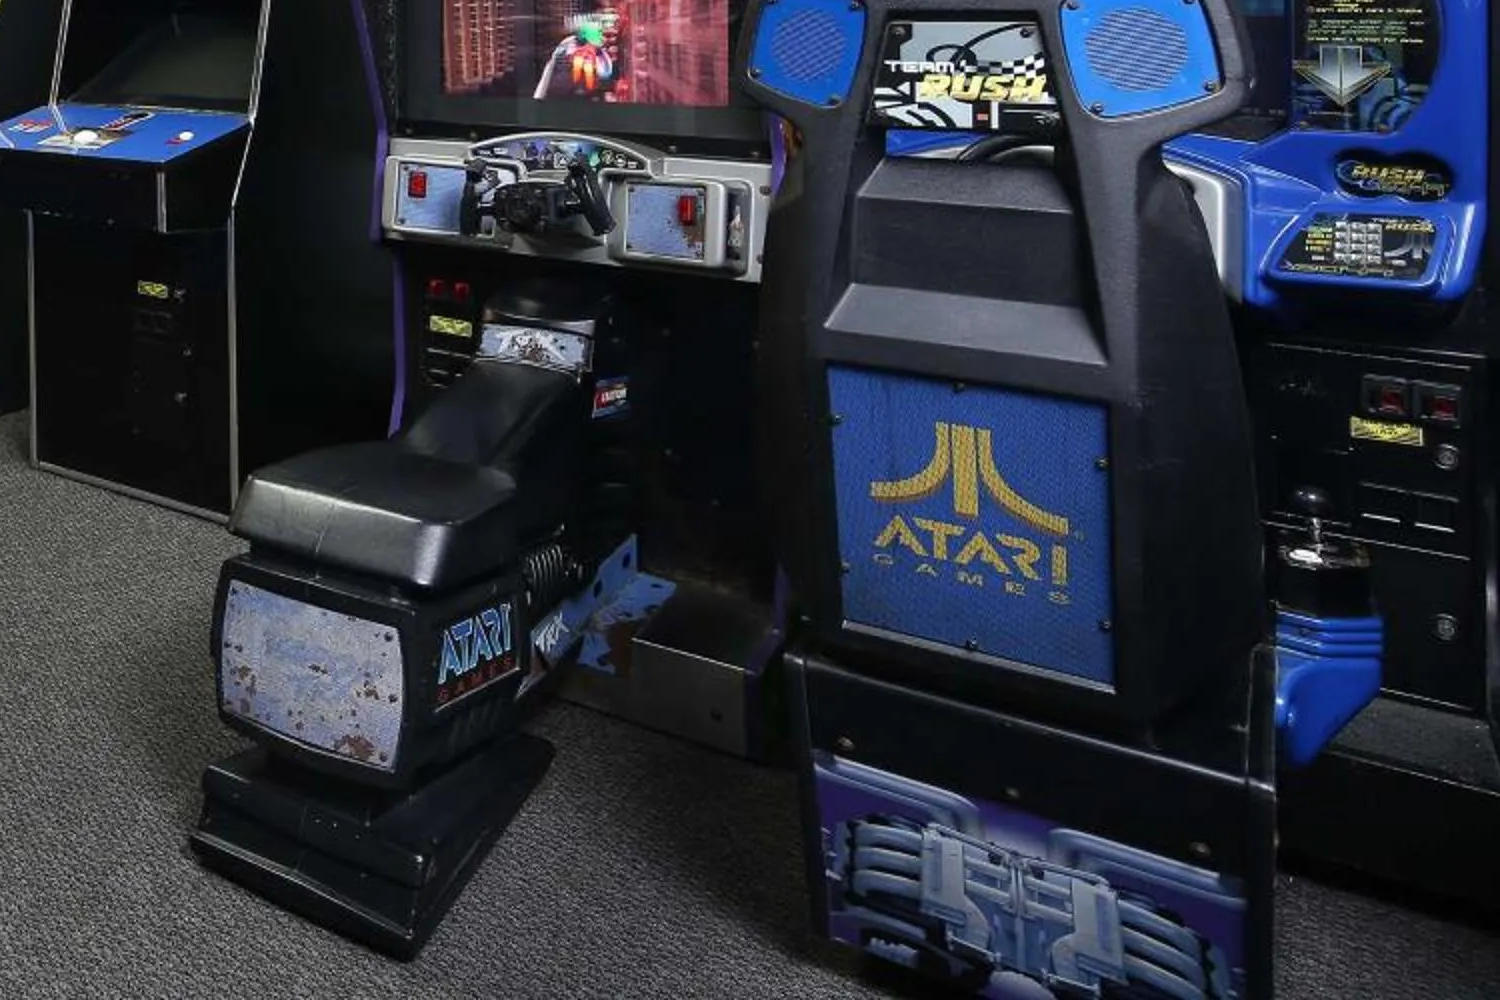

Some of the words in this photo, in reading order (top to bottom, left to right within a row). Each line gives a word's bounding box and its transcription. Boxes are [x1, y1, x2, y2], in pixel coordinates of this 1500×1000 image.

[884, 60, 955, 73] TEAM
[918, 73, 1048, 102] RUSH
[1352, 165, 1426, 181] RUSH
[871, 514, 1069, 586] ATARI
[438, 602, 512, 684] ATARI
